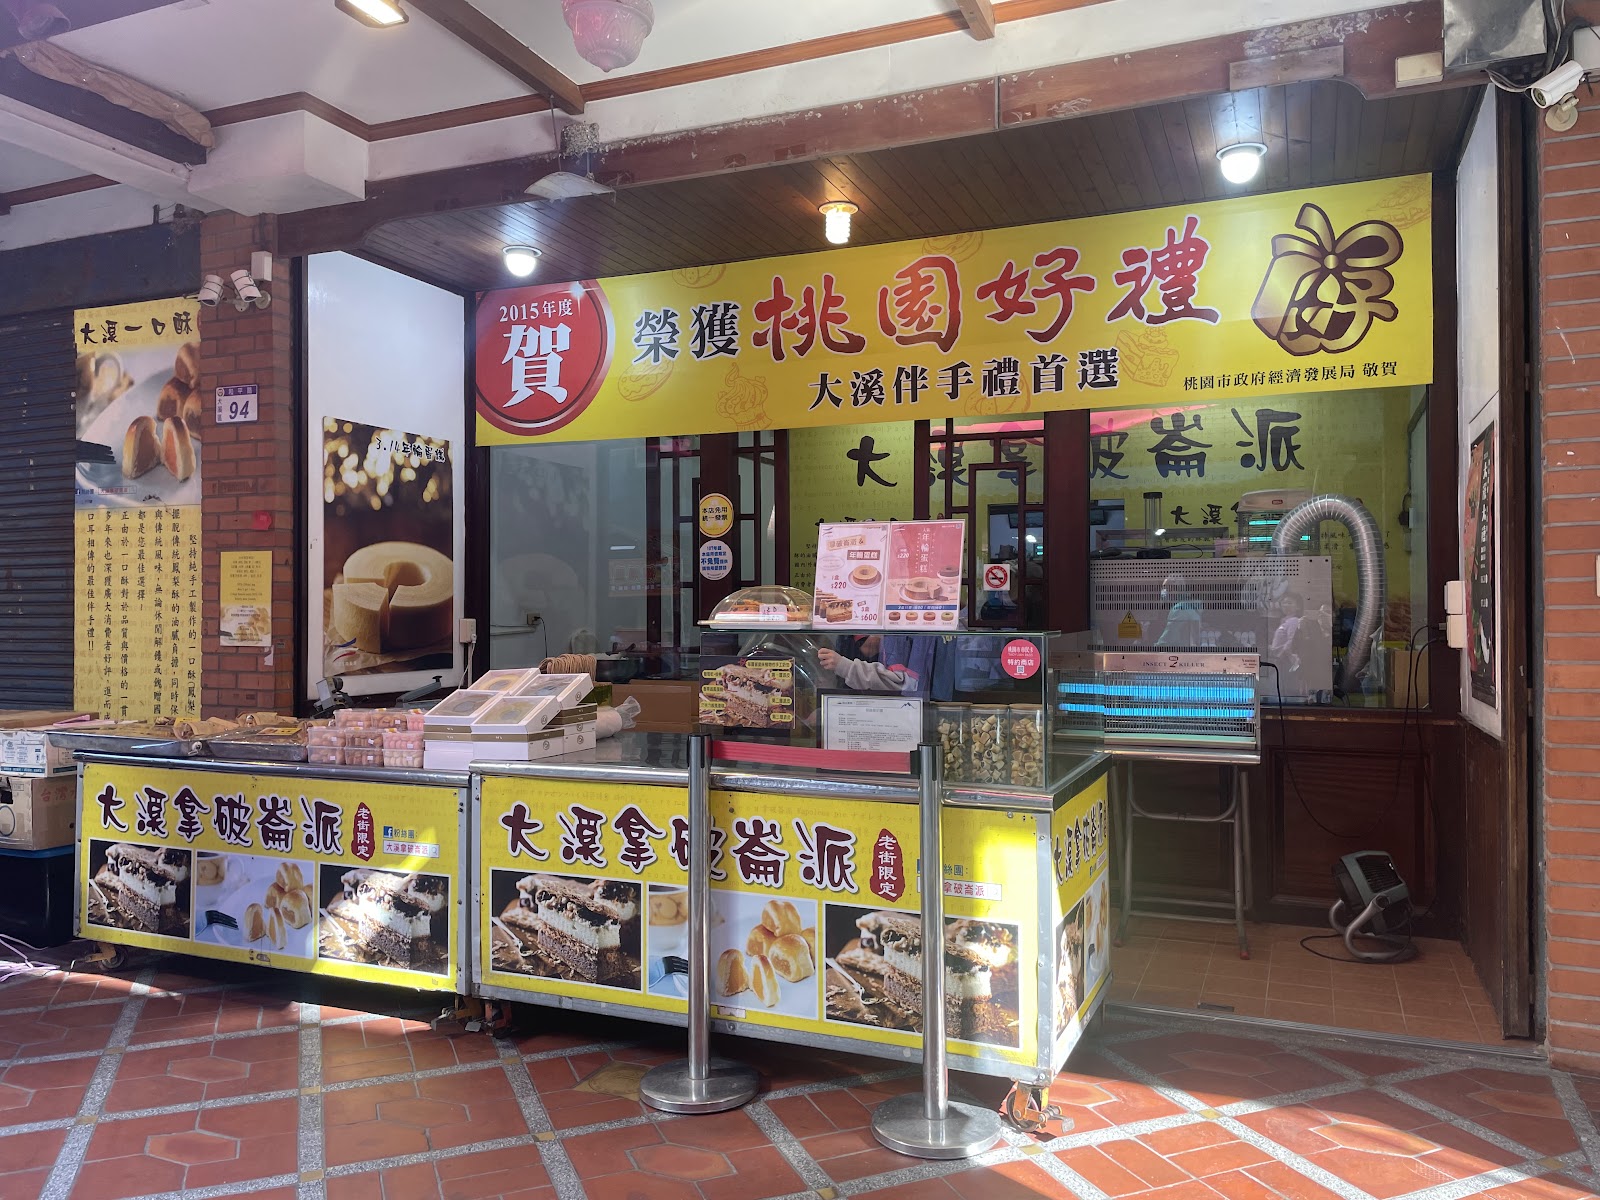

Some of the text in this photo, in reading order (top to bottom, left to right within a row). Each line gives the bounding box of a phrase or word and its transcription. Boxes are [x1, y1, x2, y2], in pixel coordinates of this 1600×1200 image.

[633, 216, 1220, 364] 榮獲 桃園好禮
[499, 298, 574, 322] 2015年度
[501, 322, 571, 409] 賀
[808, 347, 1120, 411] 大溪伴手禮首選
[1183, 361, 1398, 391] 桃園市政府經濟發展局 敬賀
[229, 401, 249, 419] 94
[831, 581, 847, 589] $220
[861, 613, 878, 621] $600
[97, 785, 344, 855] 大溪拿破崙派
[356, 804, 371, 857] 老街限定
[878, 835, 897, 898] 老街限定
[944, 863, 968, 876] 絲團:
[944, 881, 985, 897] 拿破崙派
